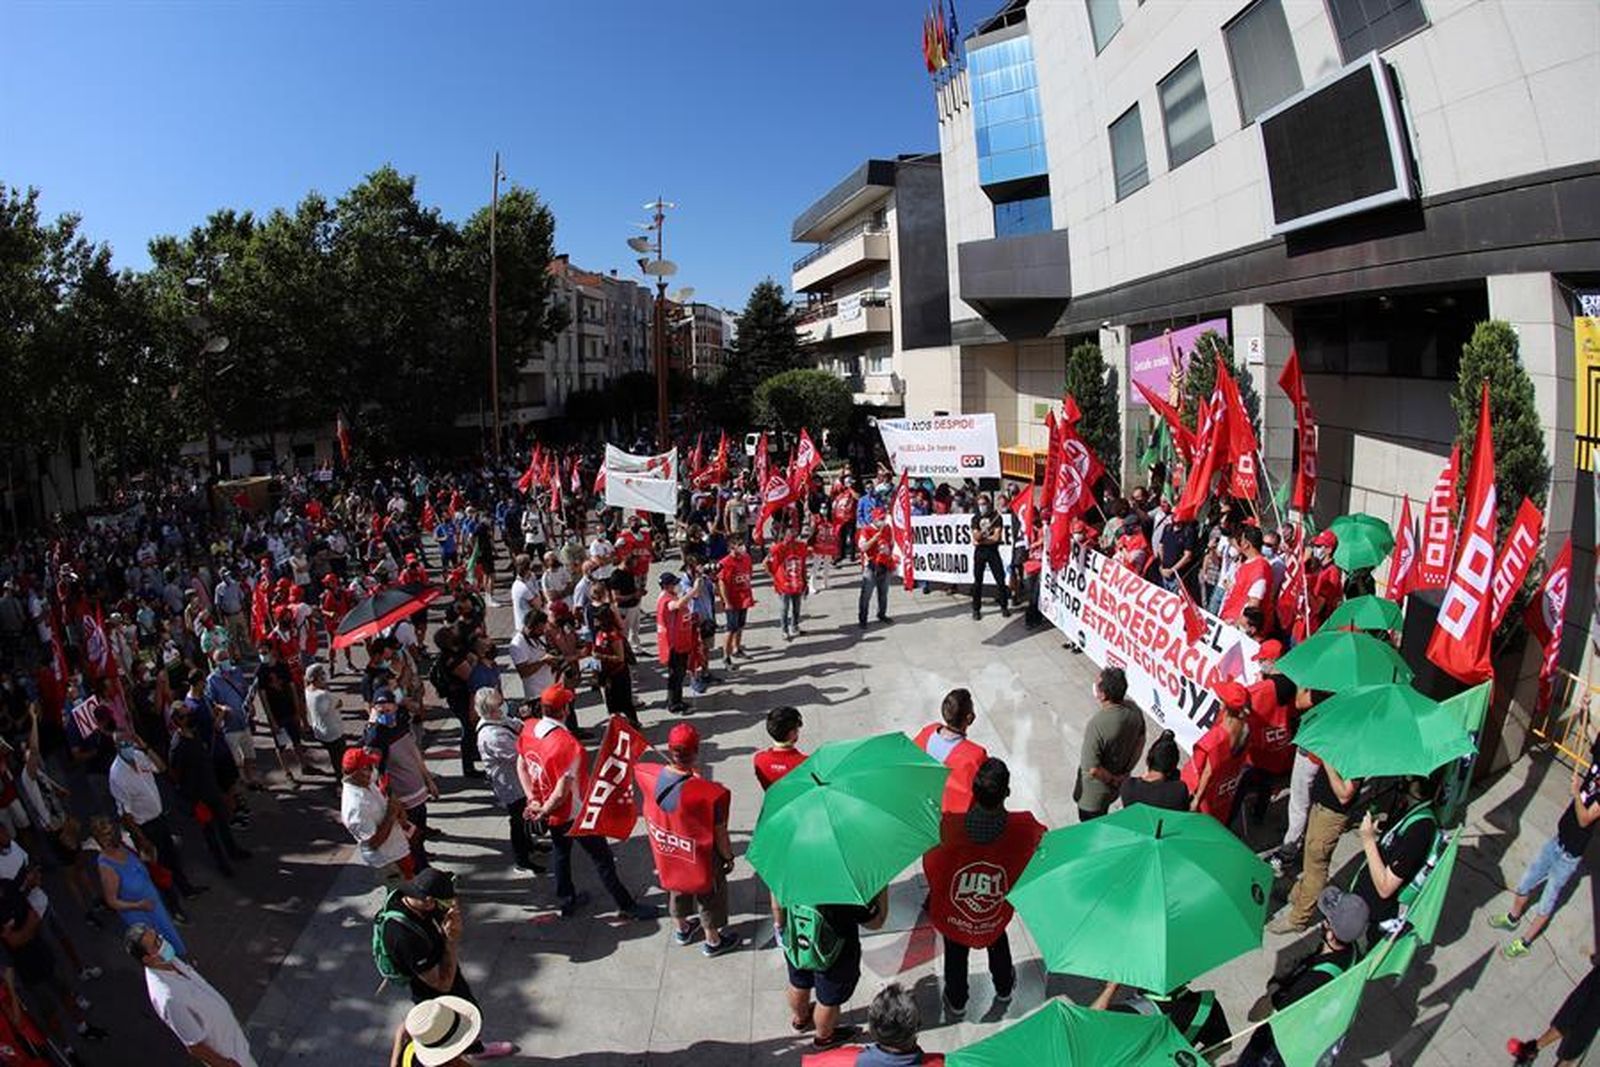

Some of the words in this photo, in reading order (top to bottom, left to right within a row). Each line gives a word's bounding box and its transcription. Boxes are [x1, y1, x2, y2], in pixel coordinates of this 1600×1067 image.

[911, 421, 932, 431] NOS
[962, 455, 984, 467] CGT
[911, 525, 954, 546] MPLEO
[927, 553, 969, 574] CALIDAD
[1084, 548, 1099, 575] EL
[1099, 558, 1181, 626] EMPLEO
[579, 730, 631, 829] CCOO
[959, 872, 1002, 897] UGT
